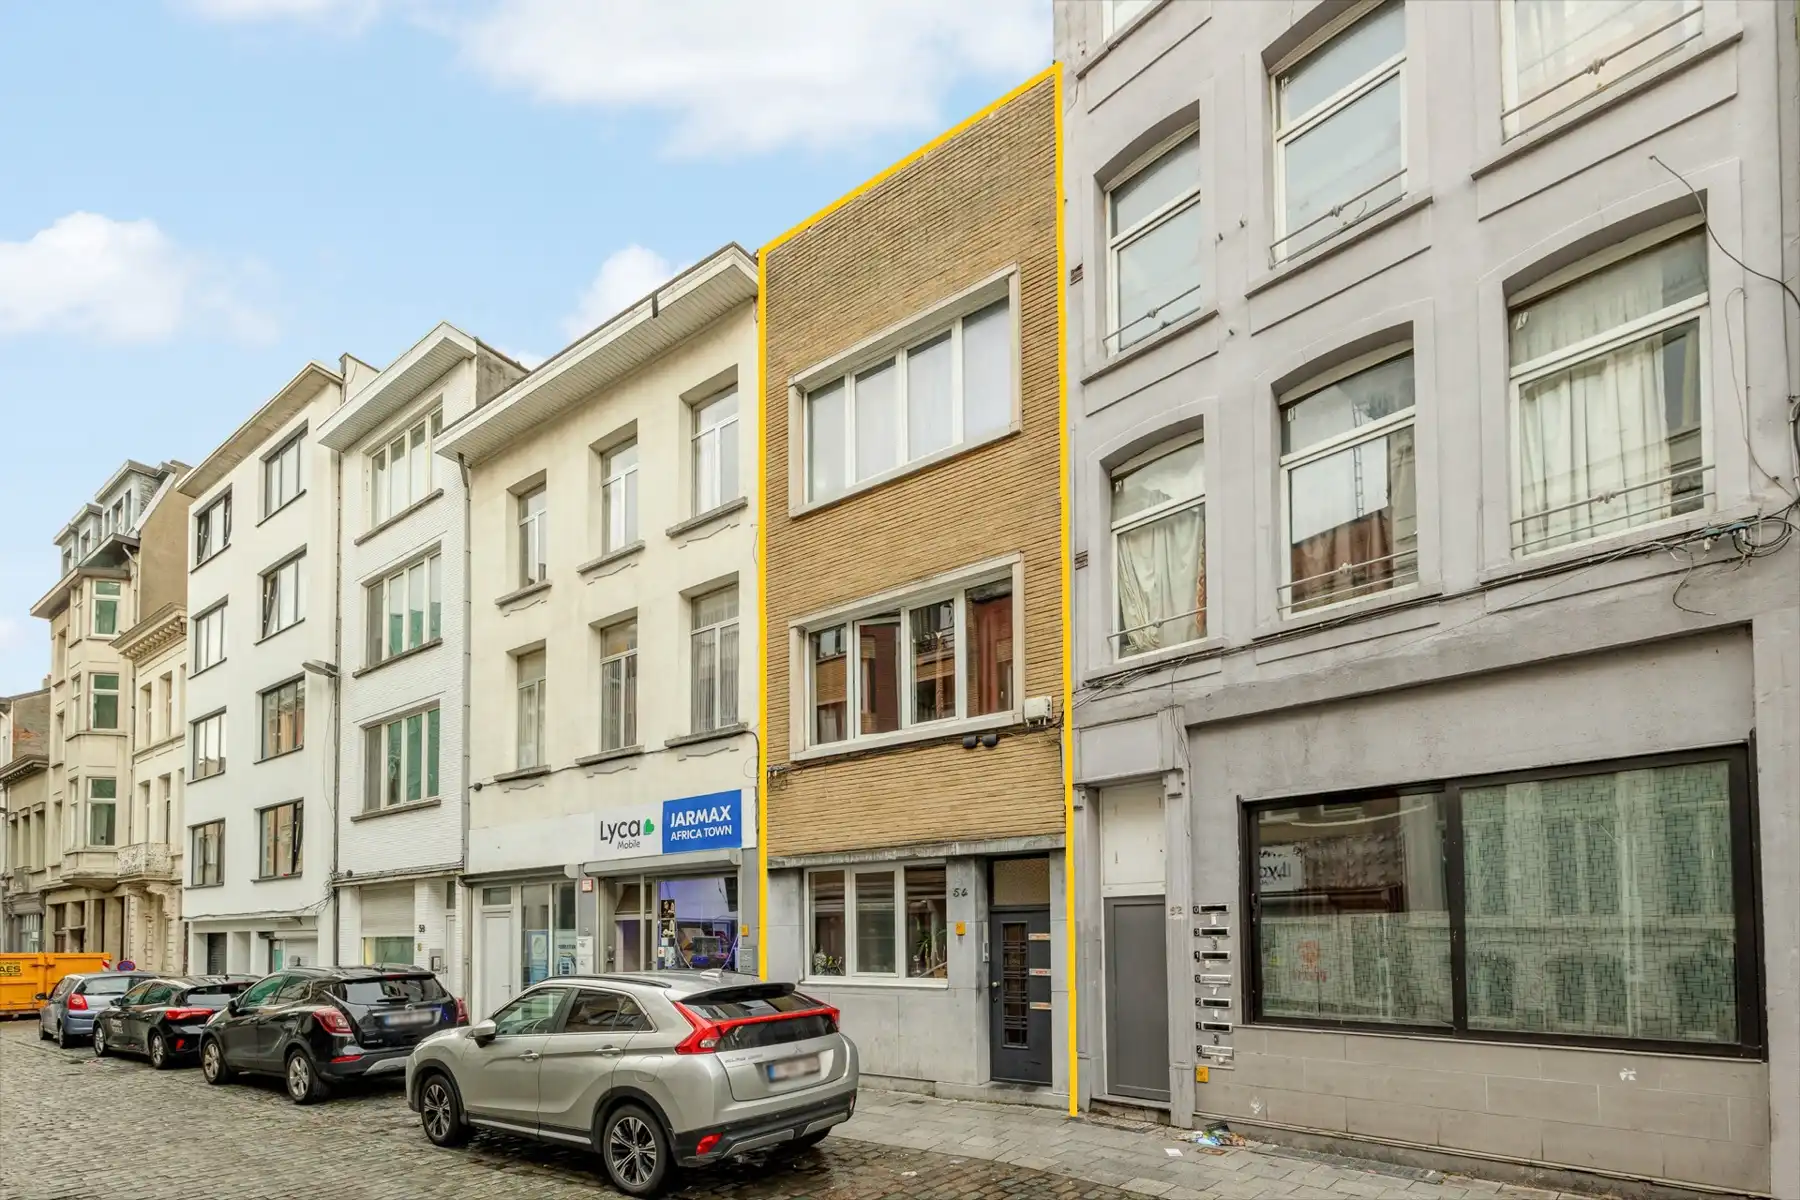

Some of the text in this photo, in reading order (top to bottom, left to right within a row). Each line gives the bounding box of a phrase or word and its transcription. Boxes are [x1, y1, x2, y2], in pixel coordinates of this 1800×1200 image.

[670, 805, 731, 828] JARMAX
[600, 819, 640, 844] Lyca
[670, 825, 732, 841] AFRICA TOWN
[617, 841, 640, 850] Mobile
[1169, 905, 1183, 916] 52
